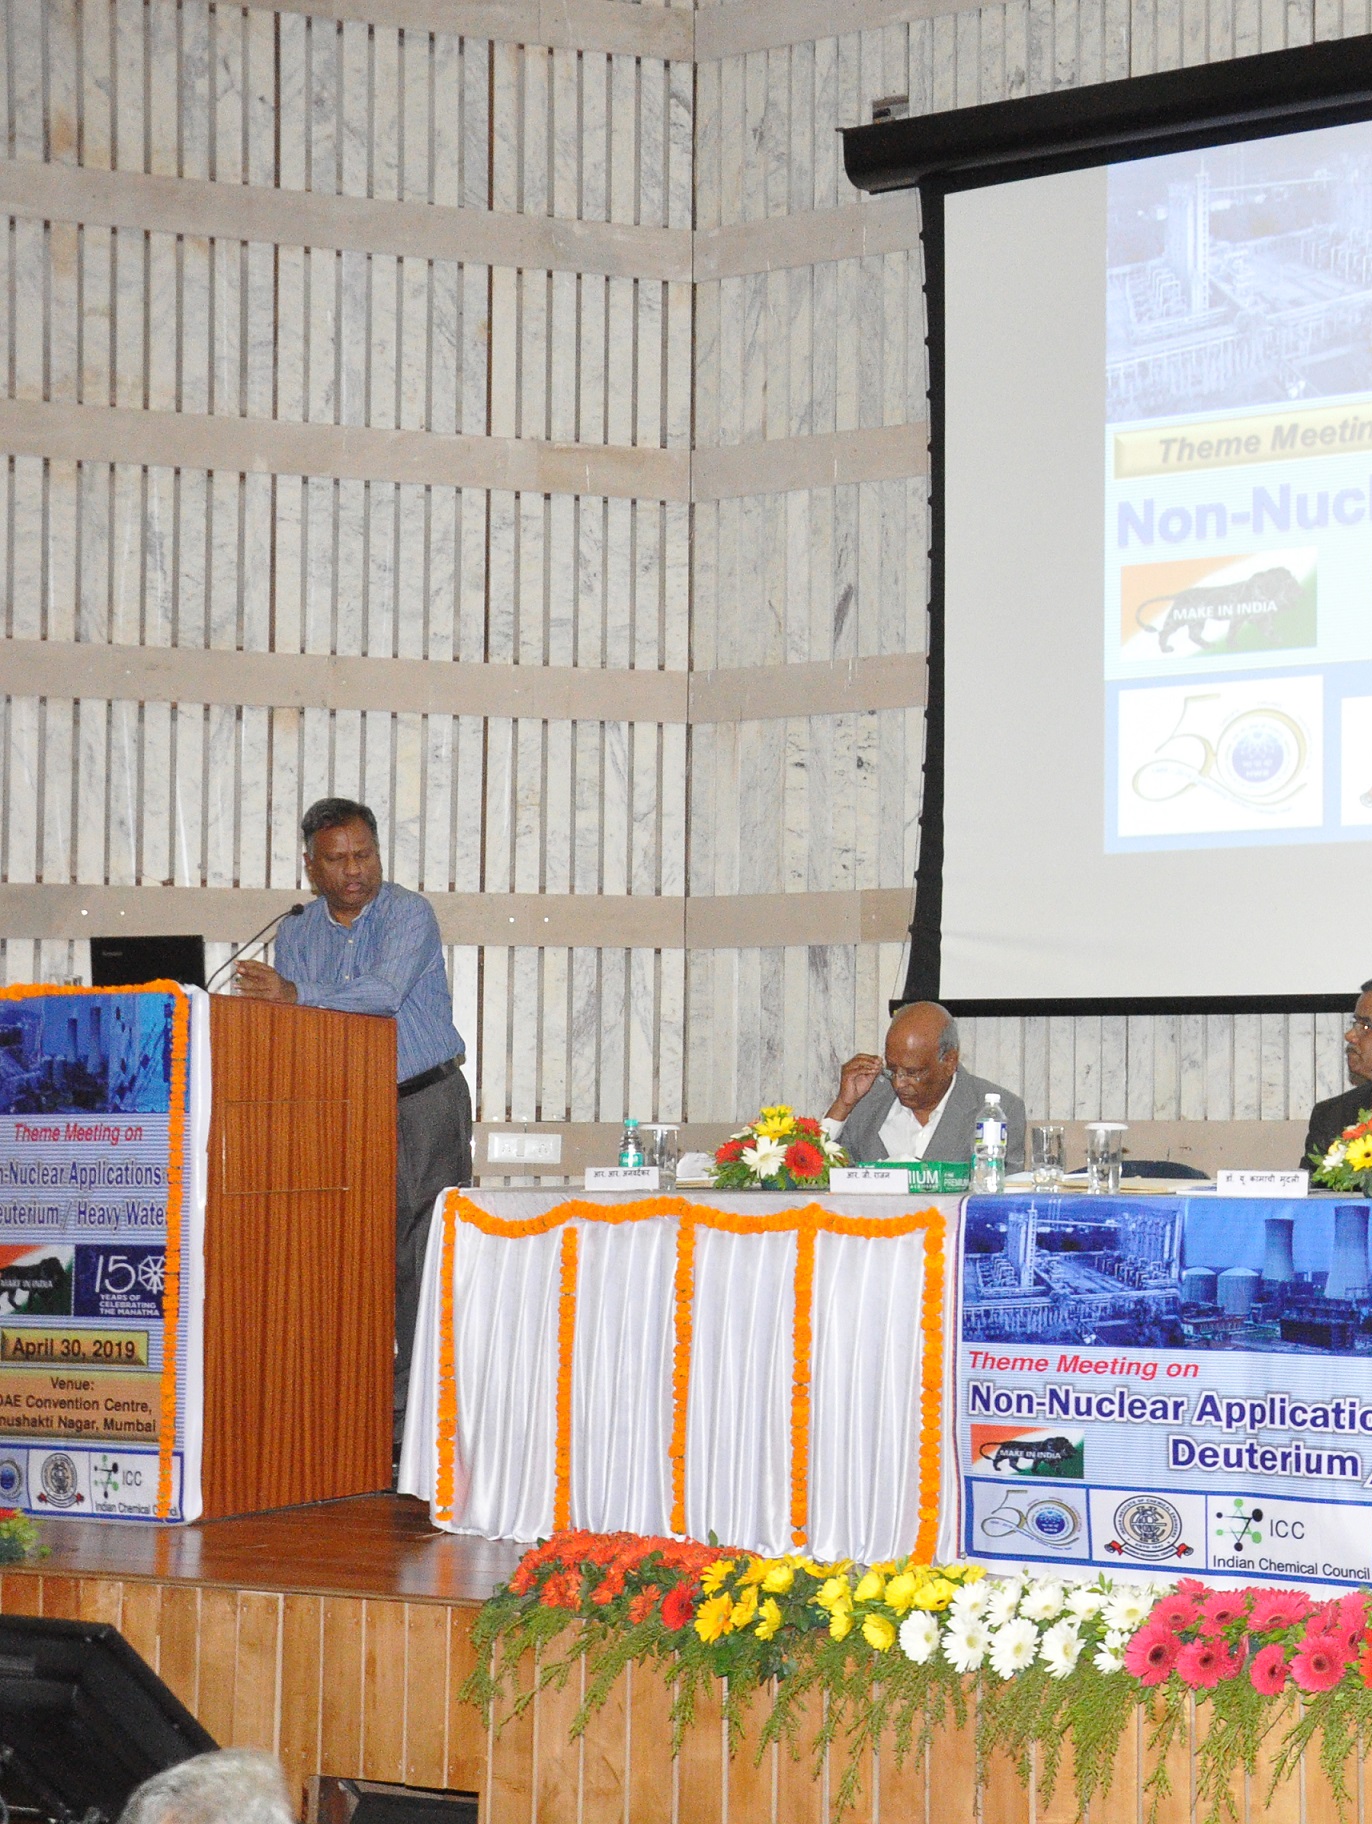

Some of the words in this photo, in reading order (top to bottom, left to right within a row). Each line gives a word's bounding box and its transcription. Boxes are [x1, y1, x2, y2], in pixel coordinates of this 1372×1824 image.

[1159, 430, 1259, 465] Theme
[1172, 604, 1216, 621] MAKE
[1218, 603, 1232, 618] IN
[1235, 599, 1278, 616] INDIA
[14, 1124, 60, 1142] Theme
[65, 1123, 120, 1146] Meeting
[125, 1126, 143, 1142] on
[69, 1160, 162, 1190] Applications
[78, 1201, 120, 1231] Heavy
[126, 1201, 168, 1225] Wate
[99, 1301, 156, 1309] CELEBRATING
[118, 1308, 159, 1316] MAHATMA
[12, 1337, 54, 1360] April
[61, 1339, 86, 1359] 30,
[93, 1340, 135, 1359] 2019
[968, 1351, 1048, 1371] Theme
[1056, 1354, 1158, 1380] Meeting
[1166, 1362, 1199, 1378] on
[50, 1377, 94, 1390] Venue:
[25, 1394, 99, 1410] Convention
[104, 1399, 152, 1414] Centre,
[970, 1383, 1186, 1422] Non-Nuclear
[58, 1416, 99, 1431] Nagar,
[103, 1419, 156, 1433] Mumbai
[1171, 1437, 1359, 1477] Deuterium
[122, 1471, 142, 1487] ICC
[95, 1501, 117, 1513] Indian
[118, 1502, 151, 1515] Chemical
[1270, 1519, 1305, 1540] ICC
[1213, 1554, 1256, 1570] Indian
[1259, 1556, 1319, 1576] Chemical
[1322, 1563, 1371, 1581] Council
